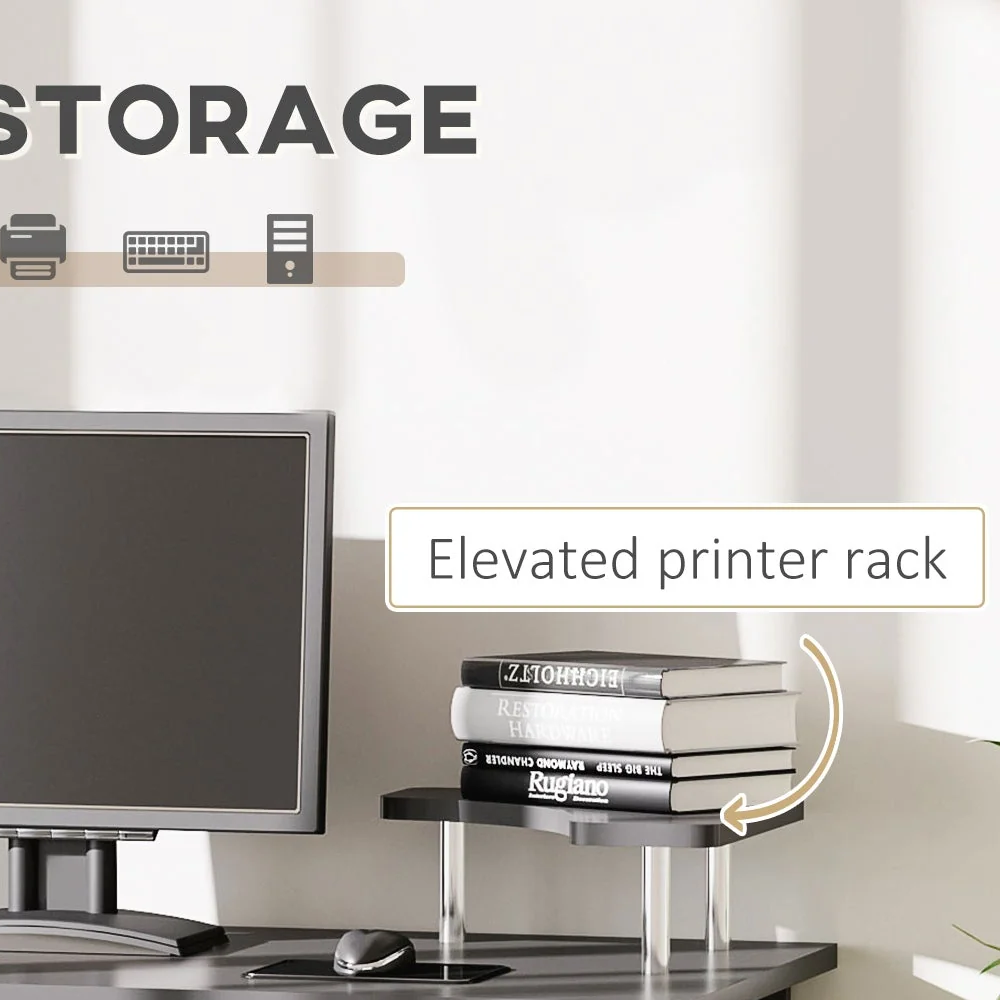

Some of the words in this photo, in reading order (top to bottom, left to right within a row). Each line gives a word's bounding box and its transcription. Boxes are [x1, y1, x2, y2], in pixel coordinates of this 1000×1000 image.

[508, 720, 613, 743] HARDWARE
[485, 754, 534, 768] CHANDLER
[537, 757, 585, 771] RAYMOND
[596, 761, 622, 774] SLEEP
[625, 763, 642, 775] BIG
[644, 764, 662, 776] THE
[528, 771, 609, 802] Rugiano
